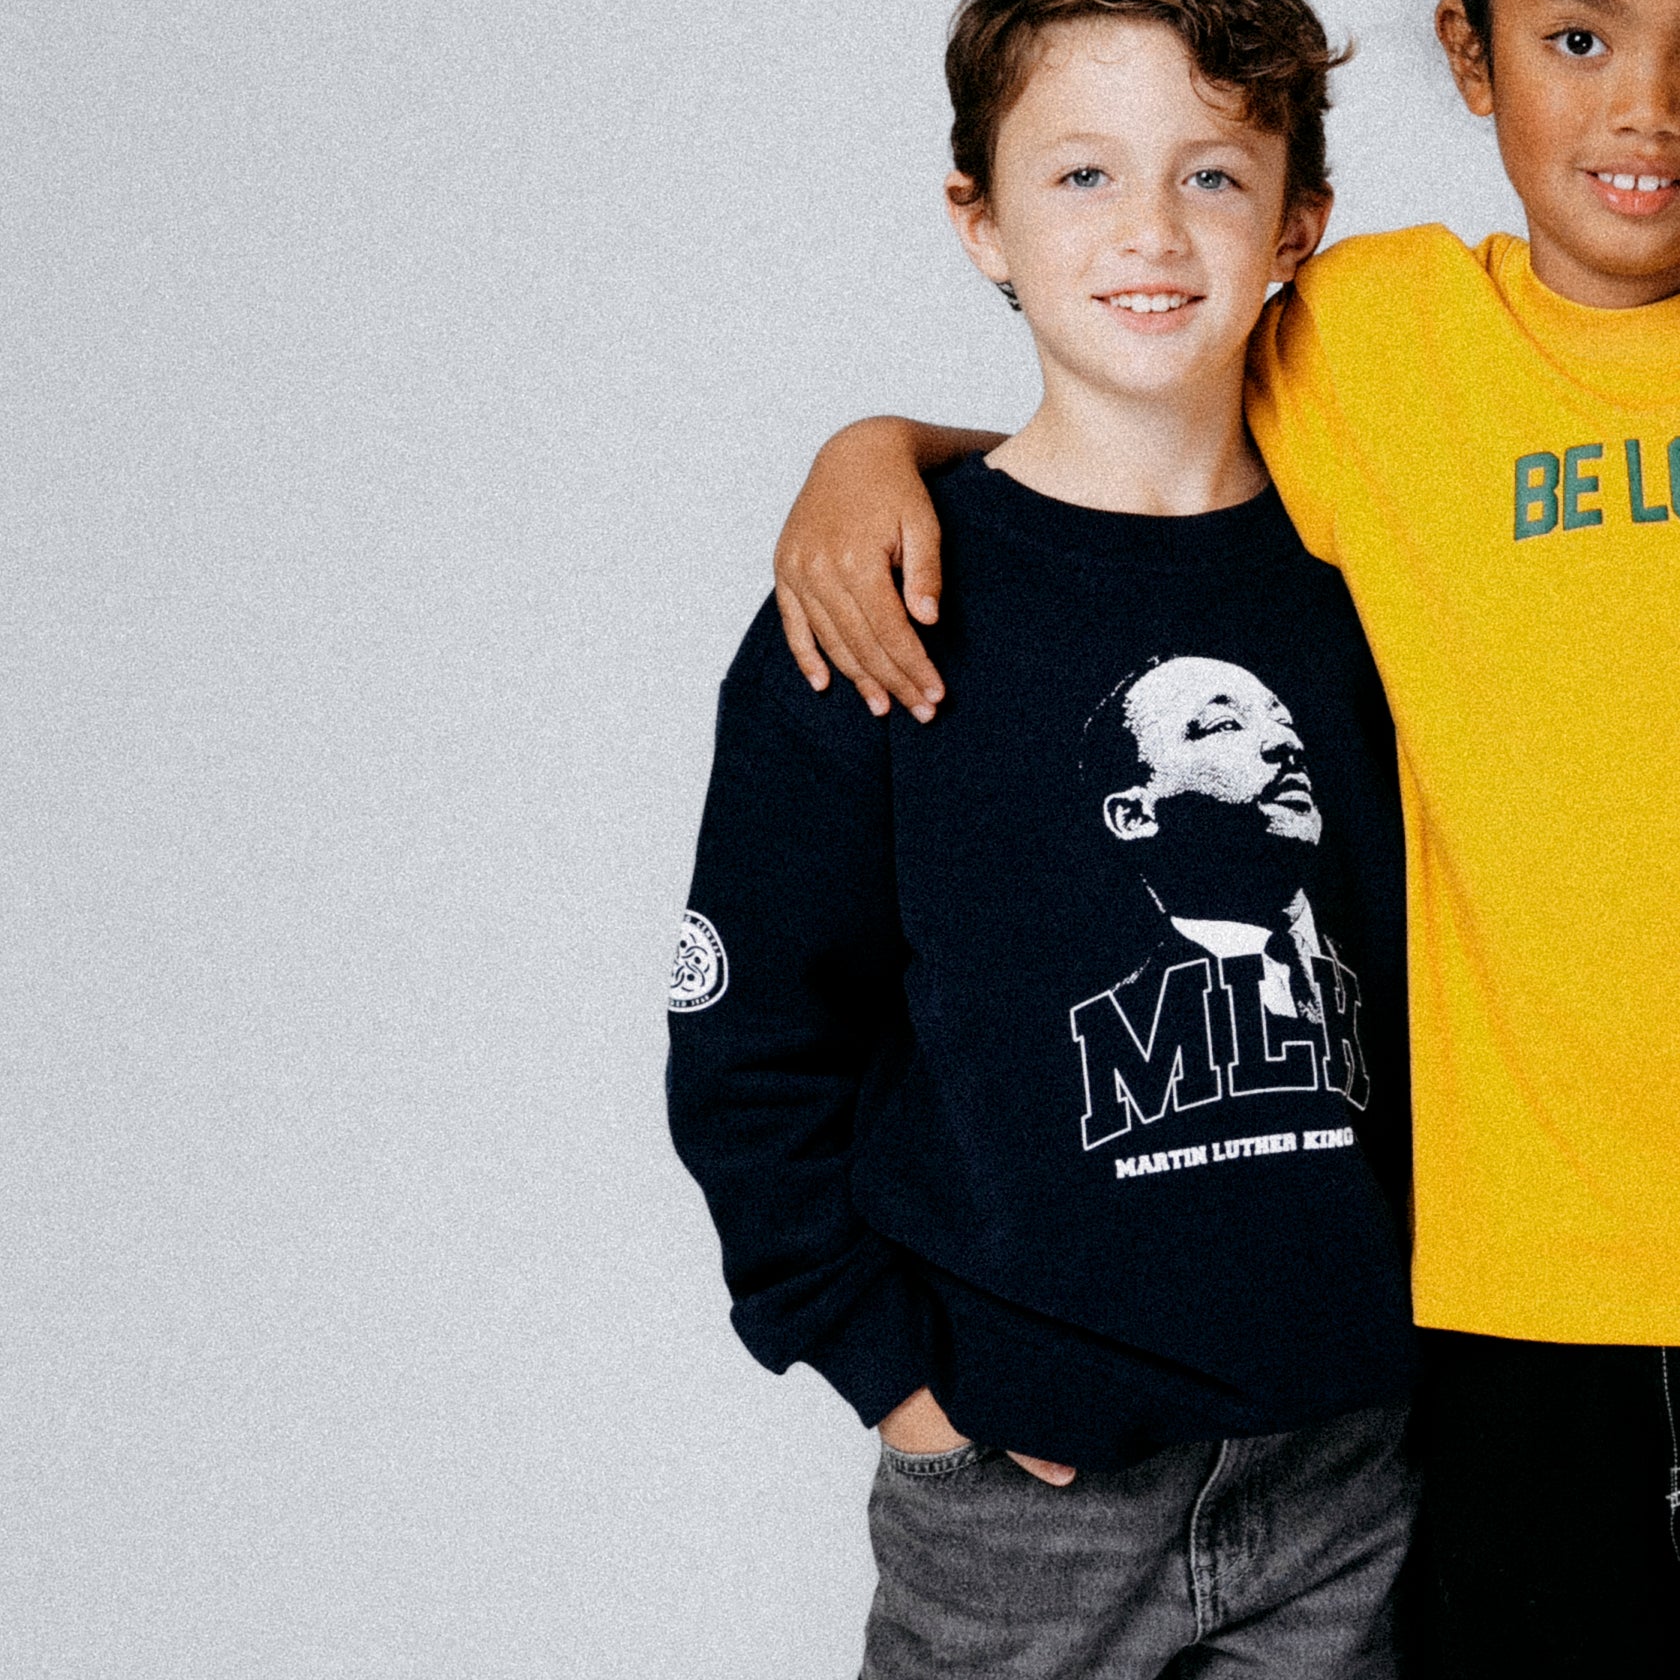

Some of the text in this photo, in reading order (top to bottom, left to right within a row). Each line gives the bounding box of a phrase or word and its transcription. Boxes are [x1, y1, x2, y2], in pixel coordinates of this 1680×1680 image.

[1514, 442, 1604, 541] BE
[1114, 1126, 1355, 1180] MARTIN LUTHER KING
